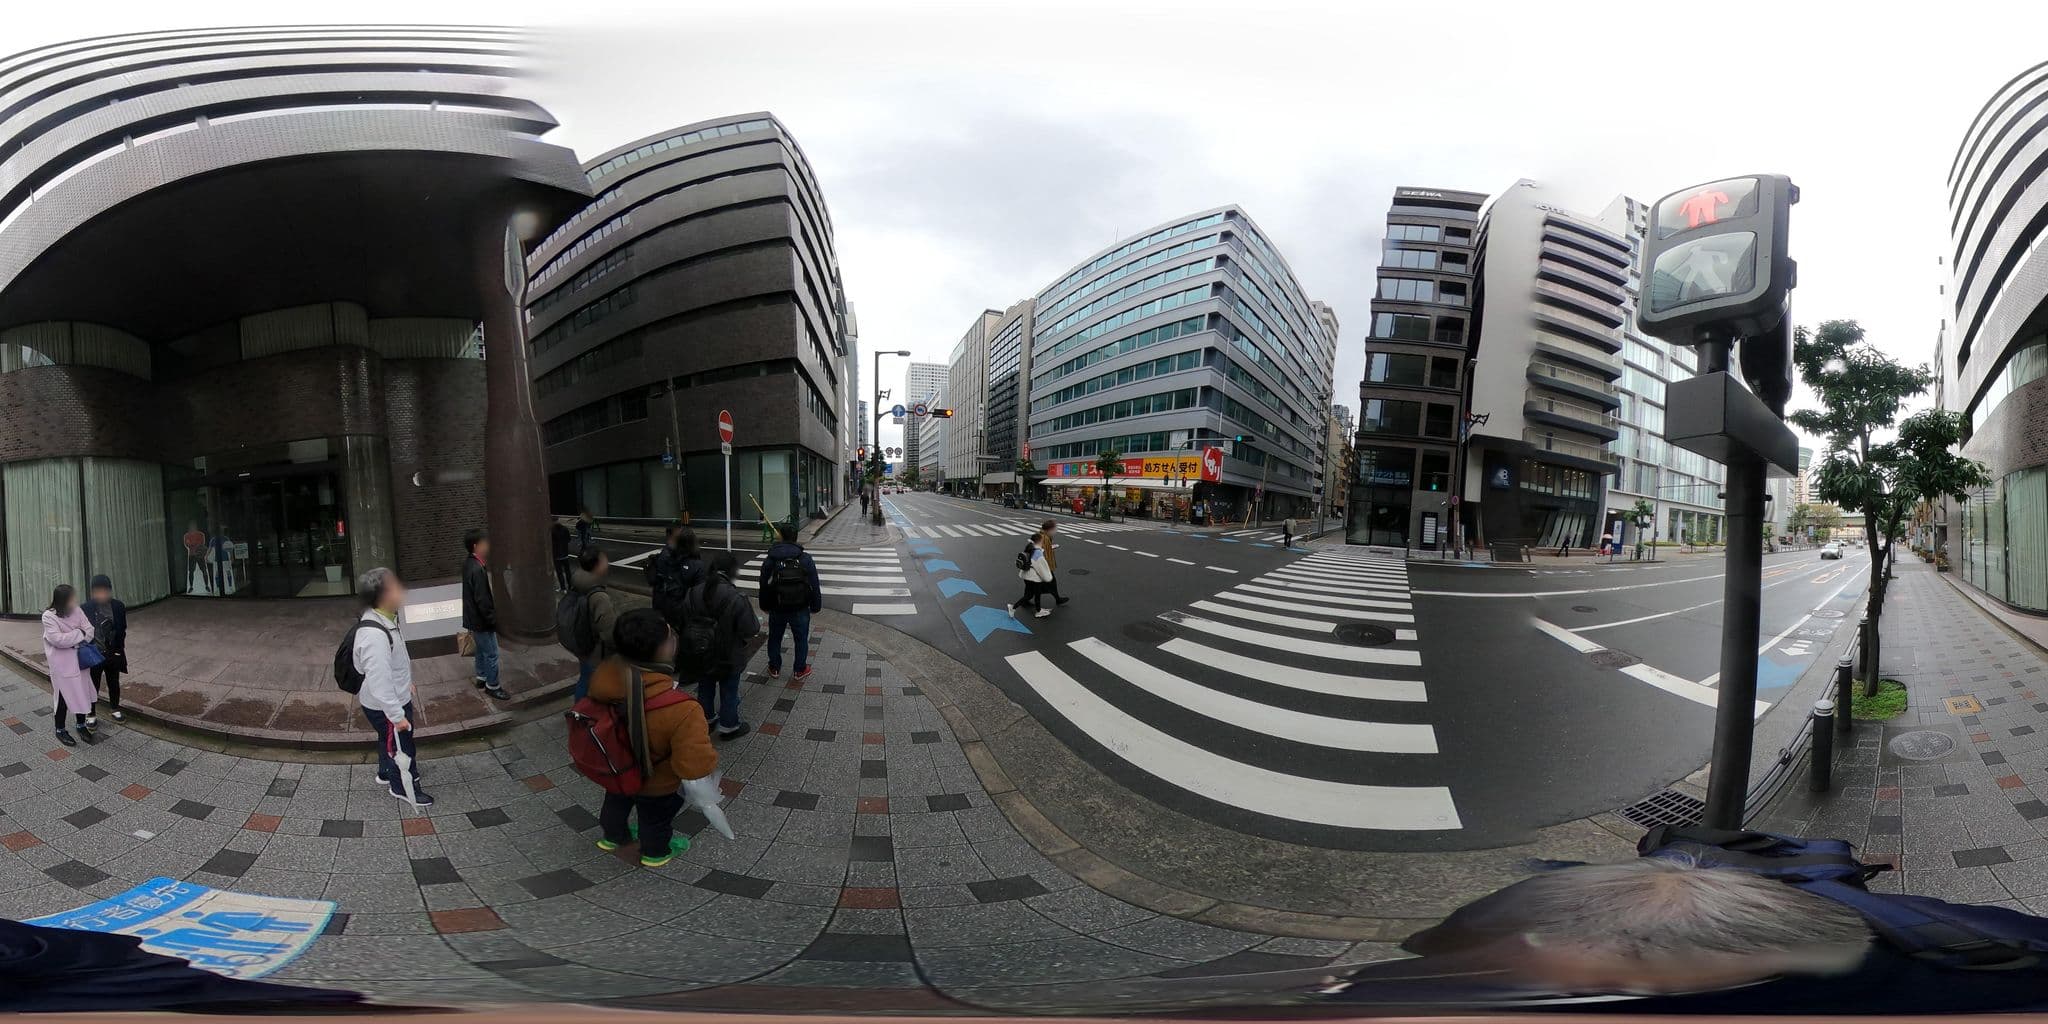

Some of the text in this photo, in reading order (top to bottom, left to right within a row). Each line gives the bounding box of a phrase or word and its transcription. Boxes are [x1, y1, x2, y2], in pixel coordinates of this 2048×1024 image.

[1144, 462, 1198, 473] 処方せん受付
[50, 881, 190, 930] 行者優先
